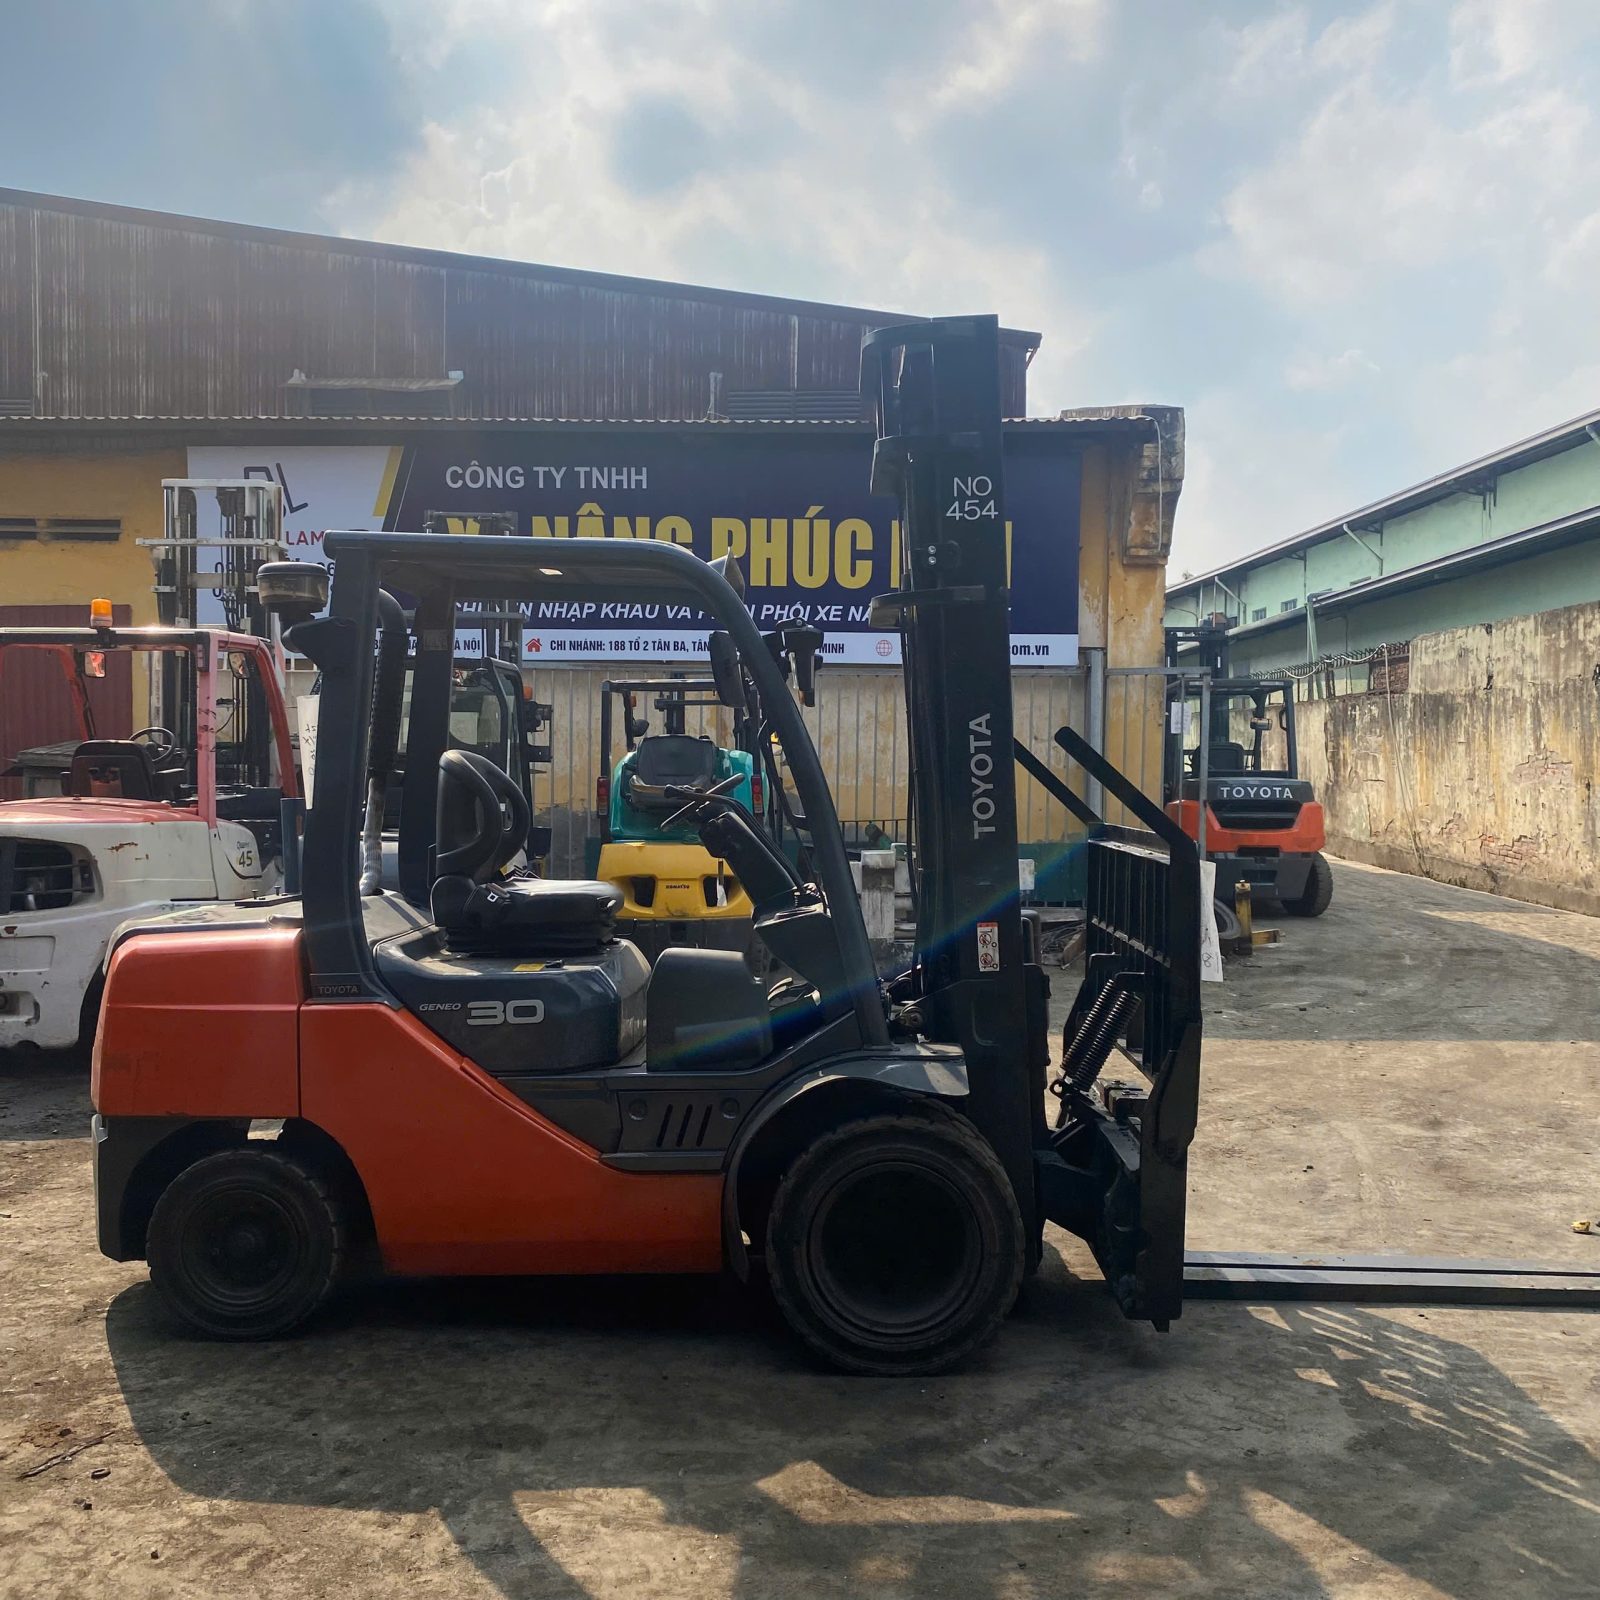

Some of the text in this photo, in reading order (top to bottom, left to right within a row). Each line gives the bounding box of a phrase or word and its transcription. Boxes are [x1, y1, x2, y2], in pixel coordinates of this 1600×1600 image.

[445, 460, 648, 489] CÔNG TY TNHH
[953, 475, 993, 497] NO
[946, 499, 999, 521] 454
[711, 505, 873, 590] PHÚC
[814, 605, 844, 621] XE
[550, 640, 566, 652] CHI
[569, 638, 606, 652] NHÁNH:
[608, 640, 626, 652] 188
[643, 640, 649, 652] 2
[652, 638, 671, 652] TÂN
[673, 640, 689, 653] BA,
[968, 712, 996, 840] TOYOTA
[1220, 786, 1293, 799] TOYOTA
[238, 850, 253, 868] 45
[318, 985, 359, 995] TOYOTA
[419, 999, 545, 1026] GENEO 30
